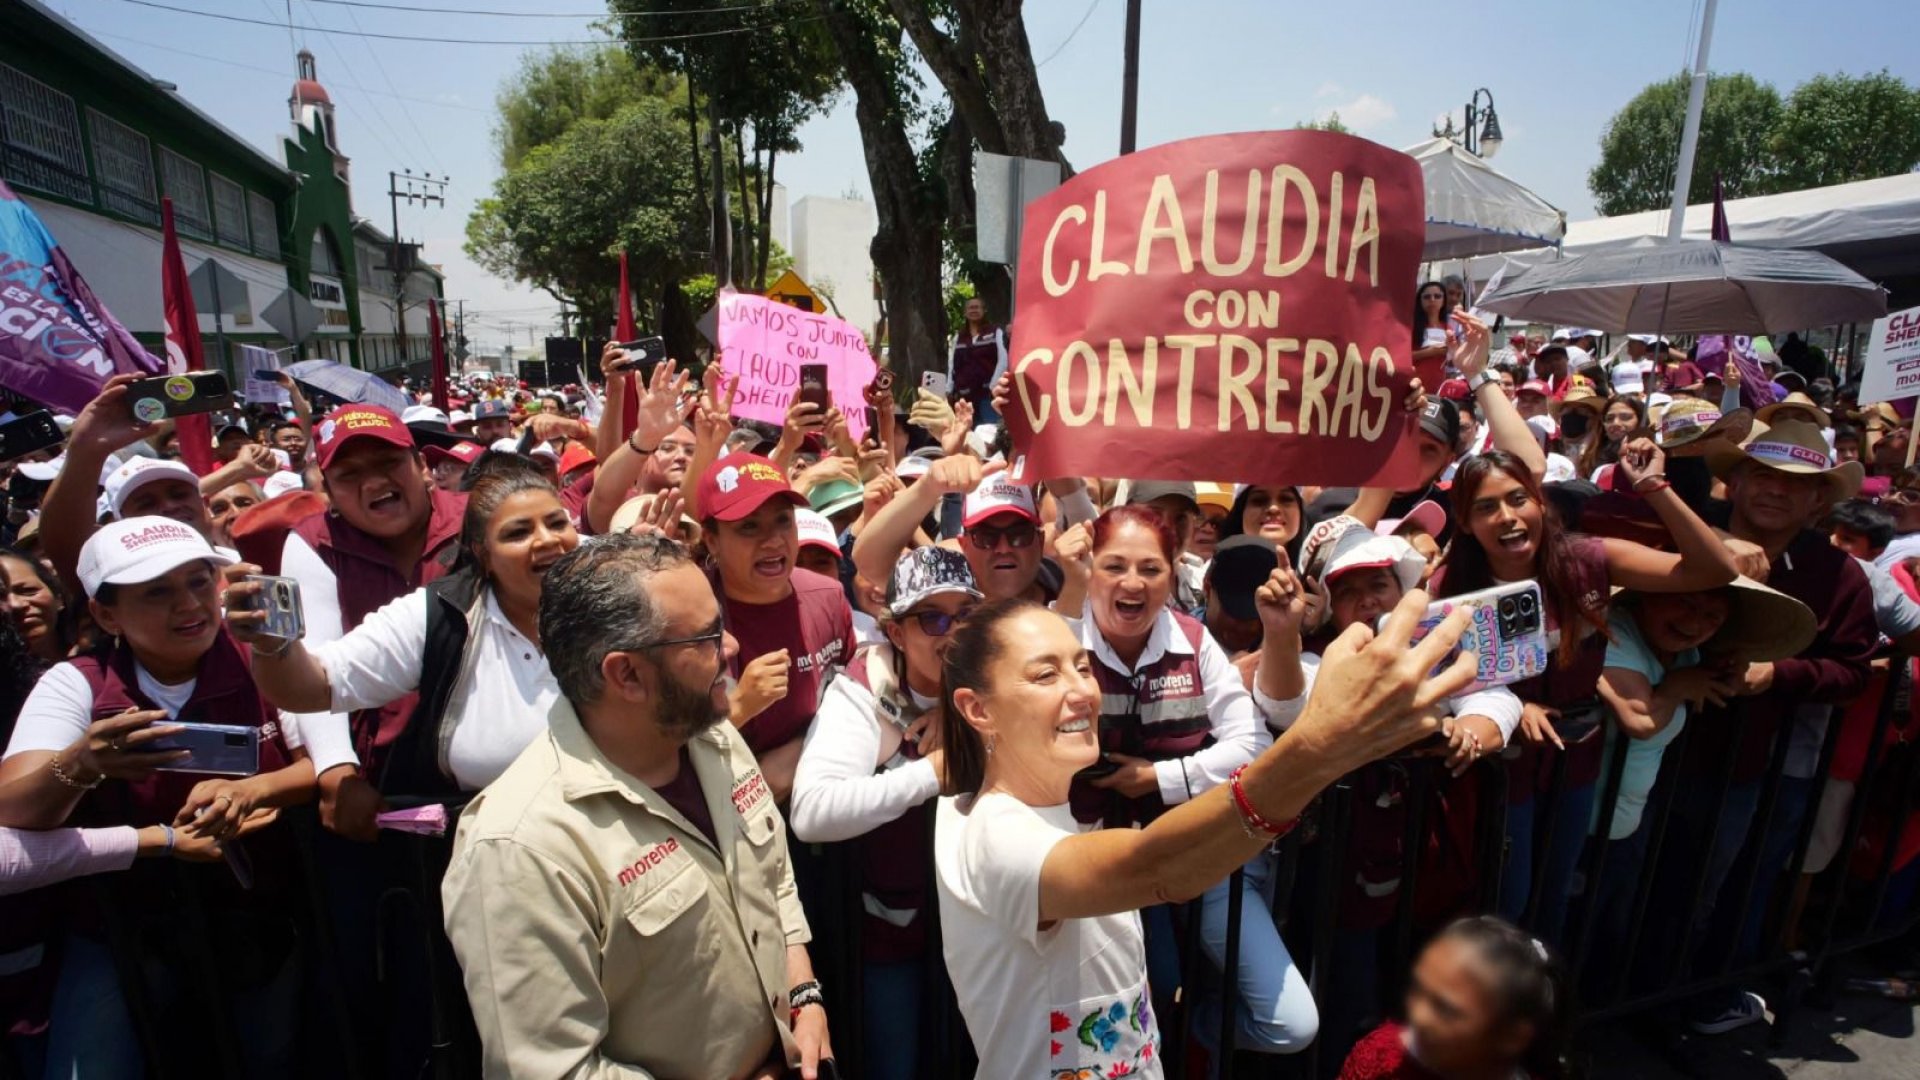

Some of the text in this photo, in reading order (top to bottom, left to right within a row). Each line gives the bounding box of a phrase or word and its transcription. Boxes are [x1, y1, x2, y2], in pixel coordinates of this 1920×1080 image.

[1042, 164, 1380, 297] CLAUDIA
[725, 303, 799, 338] VAMOS
[1184, 290, 1280, 329] CON
[786, 341, 819, 360] CON
[1014, 334, 1396, 442] CONTRERAS
[120, 524, 190, 544] CLAUDIA
[1149, 672, 1193, 690] morena
[617, 836, 679, 887] morena
